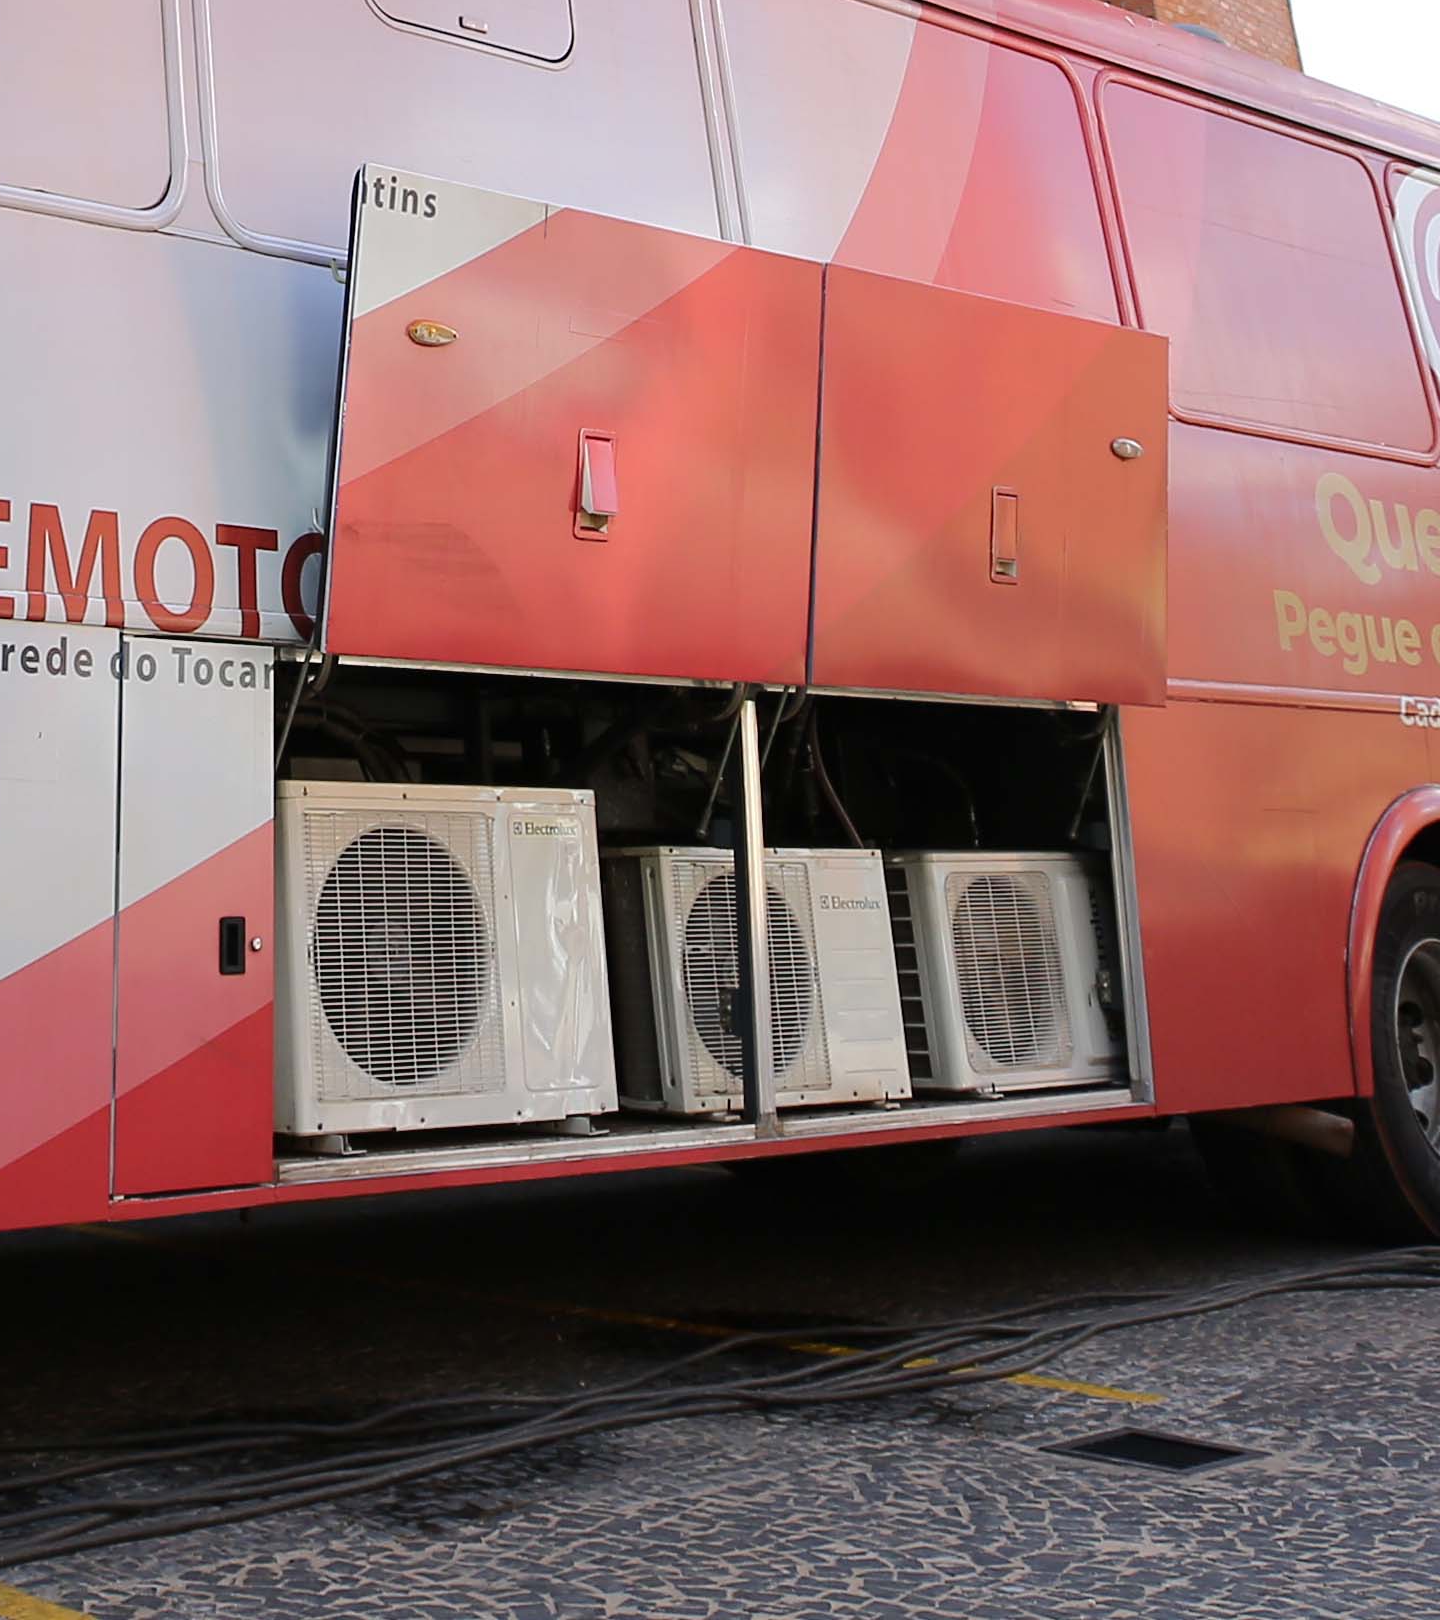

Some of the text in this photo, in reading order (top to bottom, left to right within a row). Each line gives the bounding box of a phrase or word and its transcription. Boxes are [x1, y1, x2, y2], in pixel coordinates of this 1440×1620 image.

[1273, 589, 1423, 675] Pegue
[109, 641, 158, 682] do
[524, 821, 577, 837] Electrolux
[831, 894, 881, 911] Electrolux
